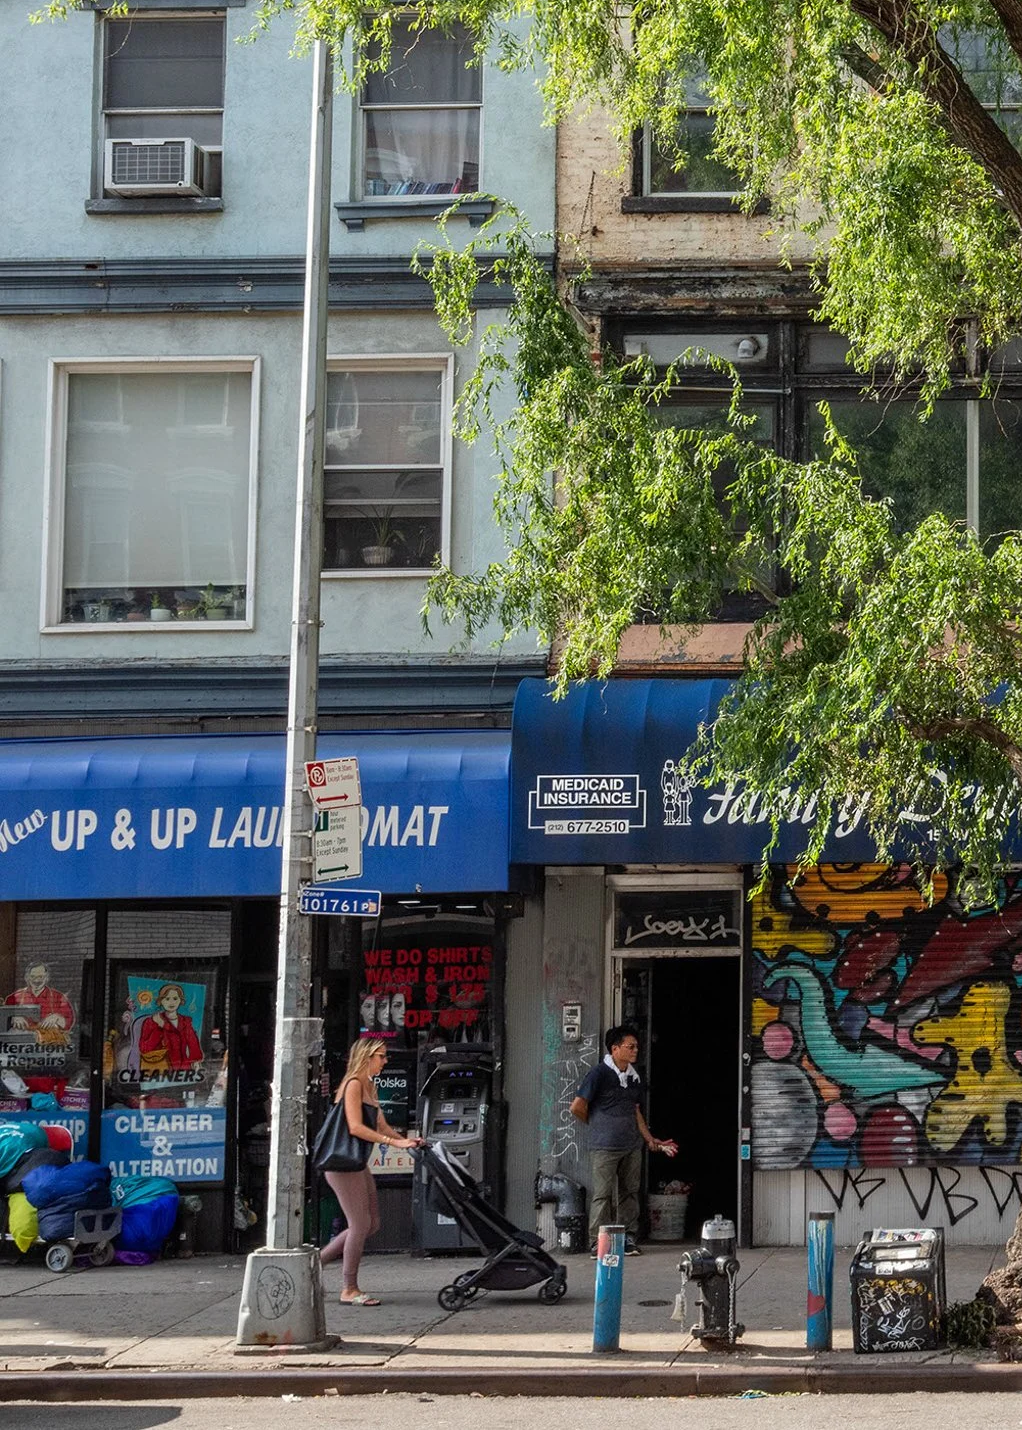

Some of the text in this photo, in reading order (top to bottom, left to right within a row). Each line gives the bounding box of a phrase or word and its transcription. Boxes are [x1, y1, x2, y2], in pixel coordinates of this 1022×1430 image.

[552, 778, 624, 791] MEDICAID
[543, 792, 632, 805] INSURANCE
[51, 809, 98, 851] UP
[110, 808, 136, 851] &
[150, 808, 197, 849] UP
[208, 805, 449, 848] LAUMAT
[547, 821, 626, 833] (212) 677-2510
[316, 846, 349, 857] Except Sunday
[304, 898, 358, 913] 101761
[364, 946, 493, 966] WE DO SHIRTS
[364, 965, 490, 984] WASH & IRON
[7, 1055, 65, 1068] Repairs
[118, 1069, 206, 1083] CLEANERS
[373, 1076, 407, 1088] Polska
[115, 1114, 213, 1134] CLEARER
[152, 1135, 173, 1156] &
[109, 1158, 218, 1178] ALTERATION
